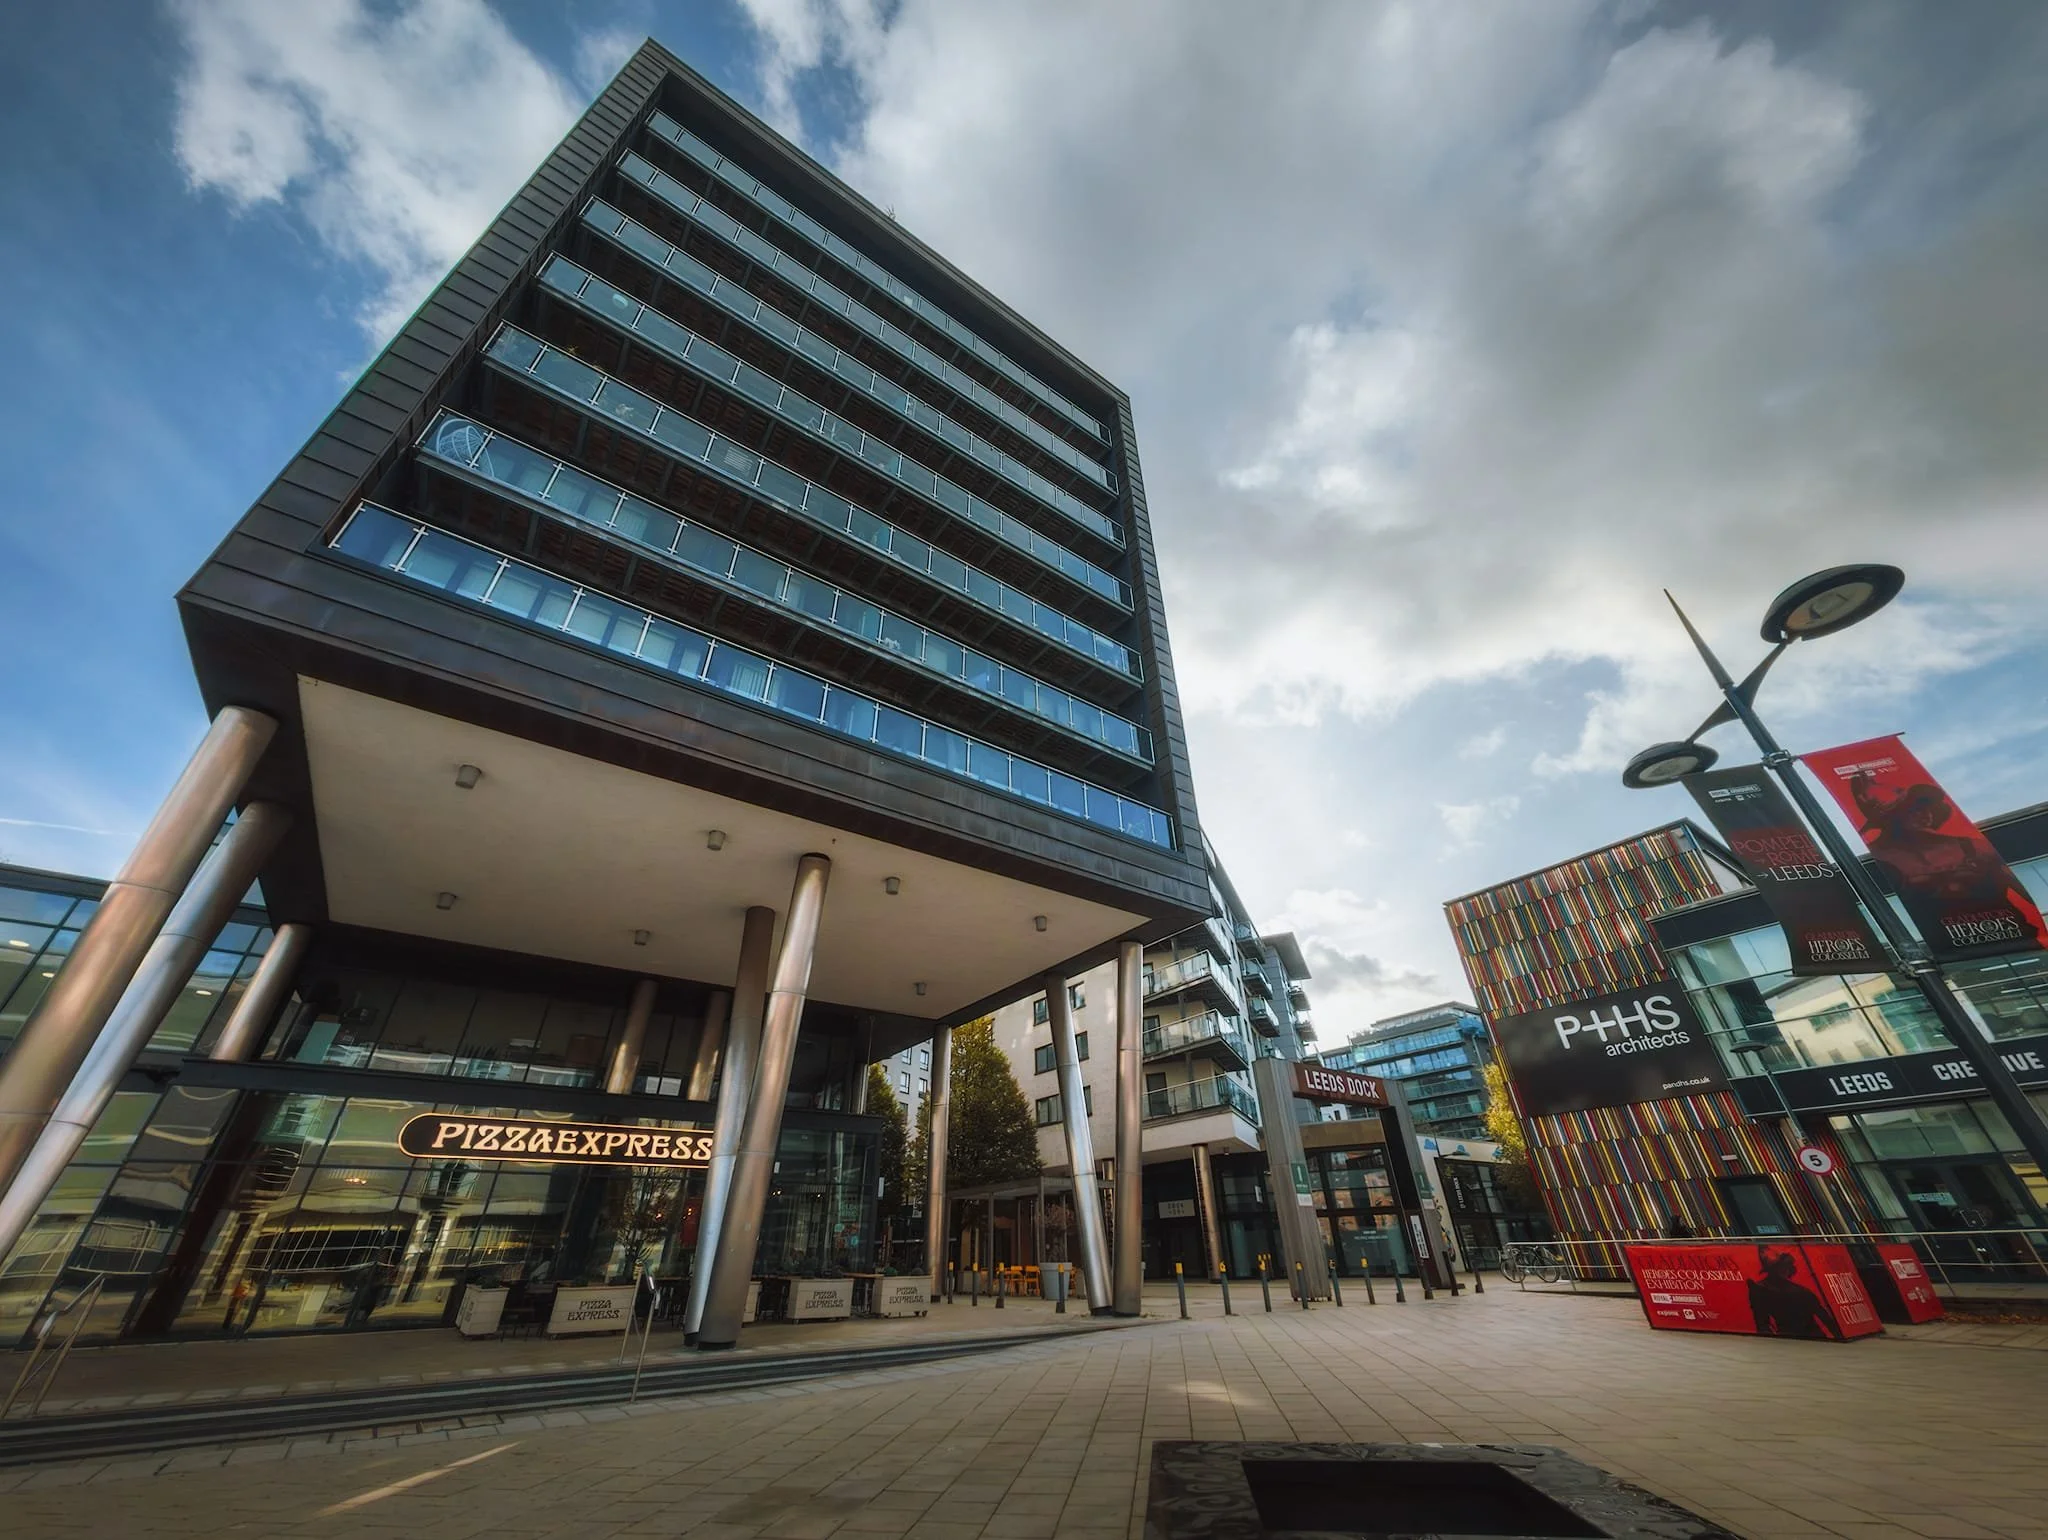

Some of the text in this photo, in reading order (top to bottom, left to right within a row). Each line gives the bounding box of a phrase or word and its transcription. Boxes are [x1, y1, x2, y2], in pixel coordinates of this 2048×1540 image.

[1766, 848, 1825, 866] ROME
[1768, 863, 1834, 882] LEEDS
[1945, 916, 2019, 939] HEROES
[1952, 929, 2024, 947] COLOSSEUM
[1808, 938, 1866, 954] HEROES
[1811, 950, 1871, 962] COLOSSEUM
[1553, 995, 1681, 1049] P+HS
[1605, 1030, 1691, 1057] architects
[1828, 1052, 2046, 1096] LEEDS CREIVE
[1303, 1069, 1380, 1099] LEEDS DOCK
[1662, 1076, 1711, 1090] pandhs.co.uk
[431, 1122, 714, 1161] PIZZAEXPRESS
[1809, 1154, 1823, 1168] 5
[1642, 1268, 1744, 1281] HEROES COLOSSEUM
[896, 1286, 918, 1296] PIZZA
[1646, 1278, 1705, 1291] EXHIBITION
[812, 1290, 838, 1300] PIZZA
[889, 1295, 924, 1305] EXPRESS
[579, 1299, 612, 1310] PIZZA
[805, 1299, 844, 1309] EXPRESS
[567, 1309, 621, 1321] EXPRESS
